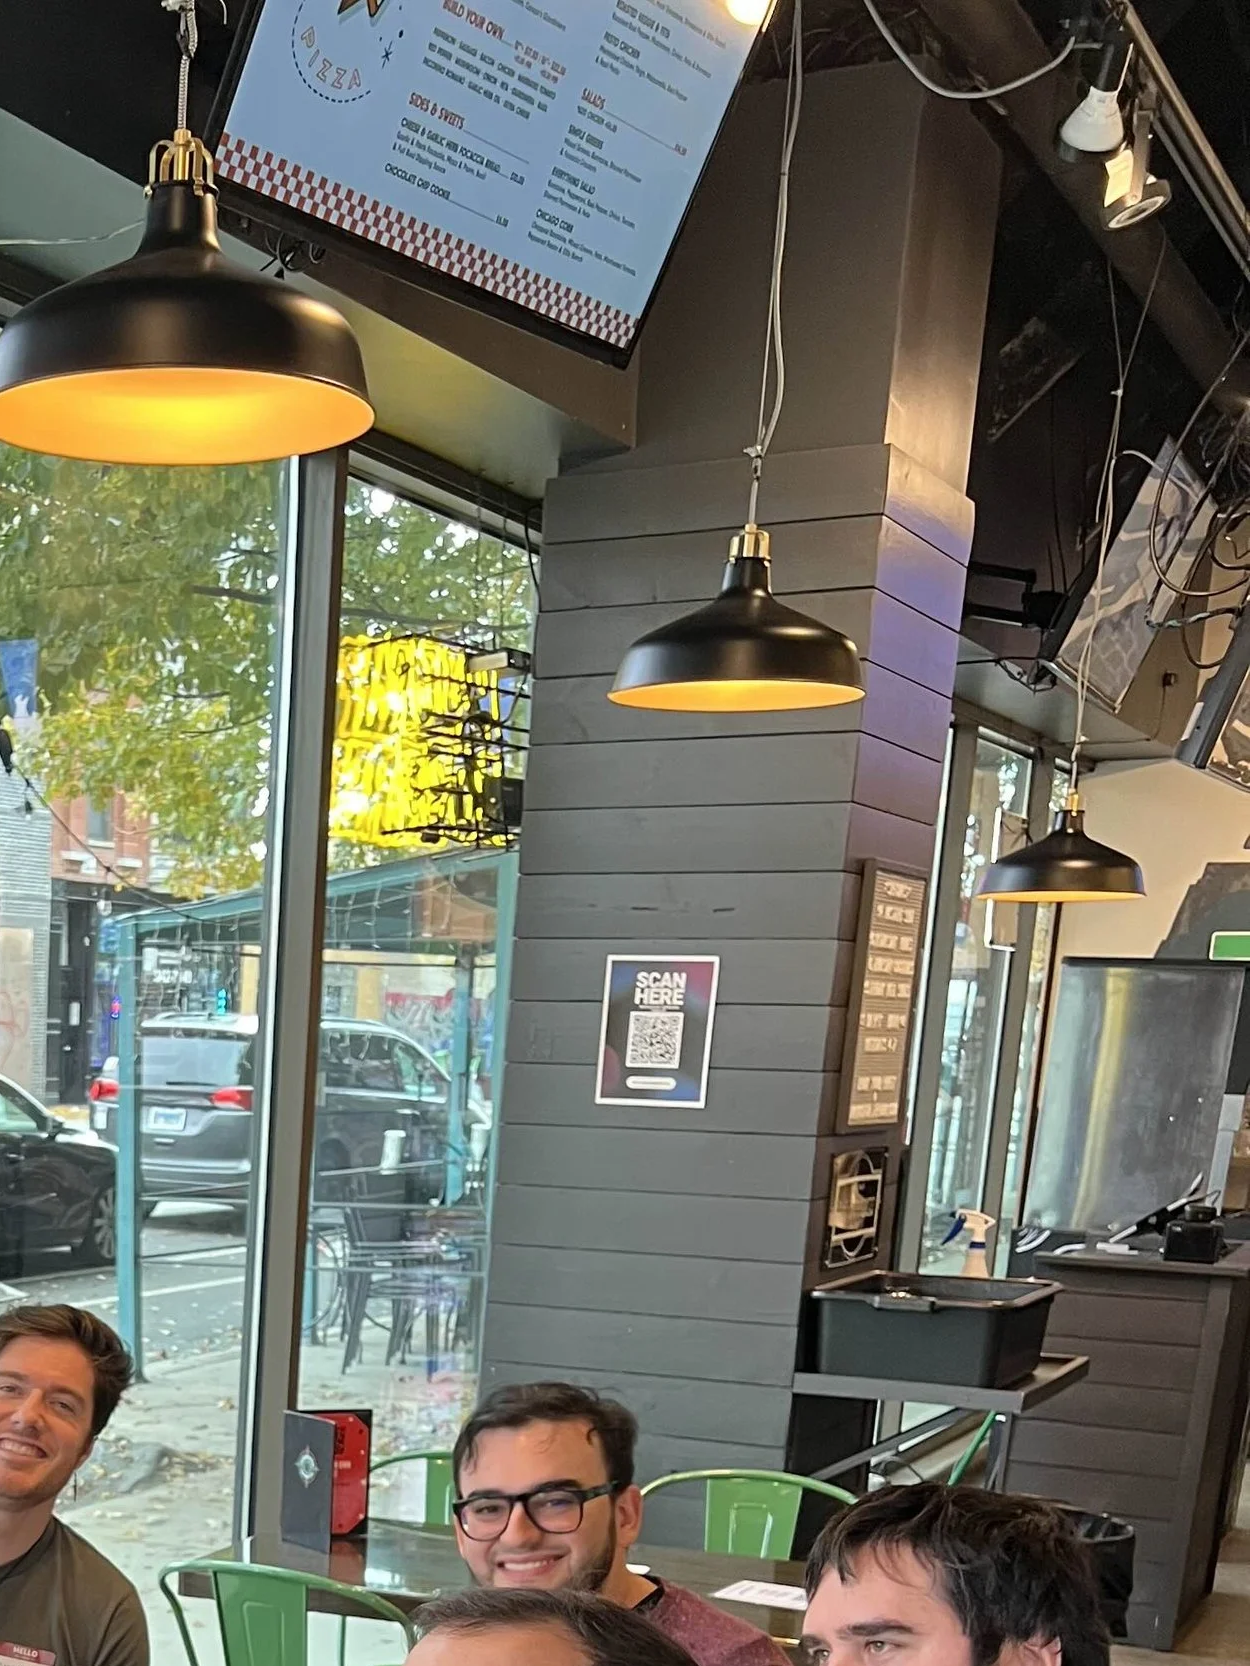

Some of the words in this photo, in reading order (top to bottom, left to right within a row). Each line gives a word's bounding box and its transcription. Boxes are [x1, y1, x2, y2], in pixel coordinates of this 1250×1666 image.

[301, 26, 361, 89] PIZZA
[581, 87, 606, 110] SALADS
[409, 92, 430, 112] SIDES
[430, 102, 438, 116] &
[438, 107, 465, 130] SWEETS
[385, 163, 416, 184] CHOCOLATE
[430, 184, 450, 200] COOKIE
[536, 208, 559, 226] CHICAGO
[635, 971, 687, 989] SCAN
[634, 987, 685, 1005] HERE
[13, 1645, 39, 1658] HELLO
